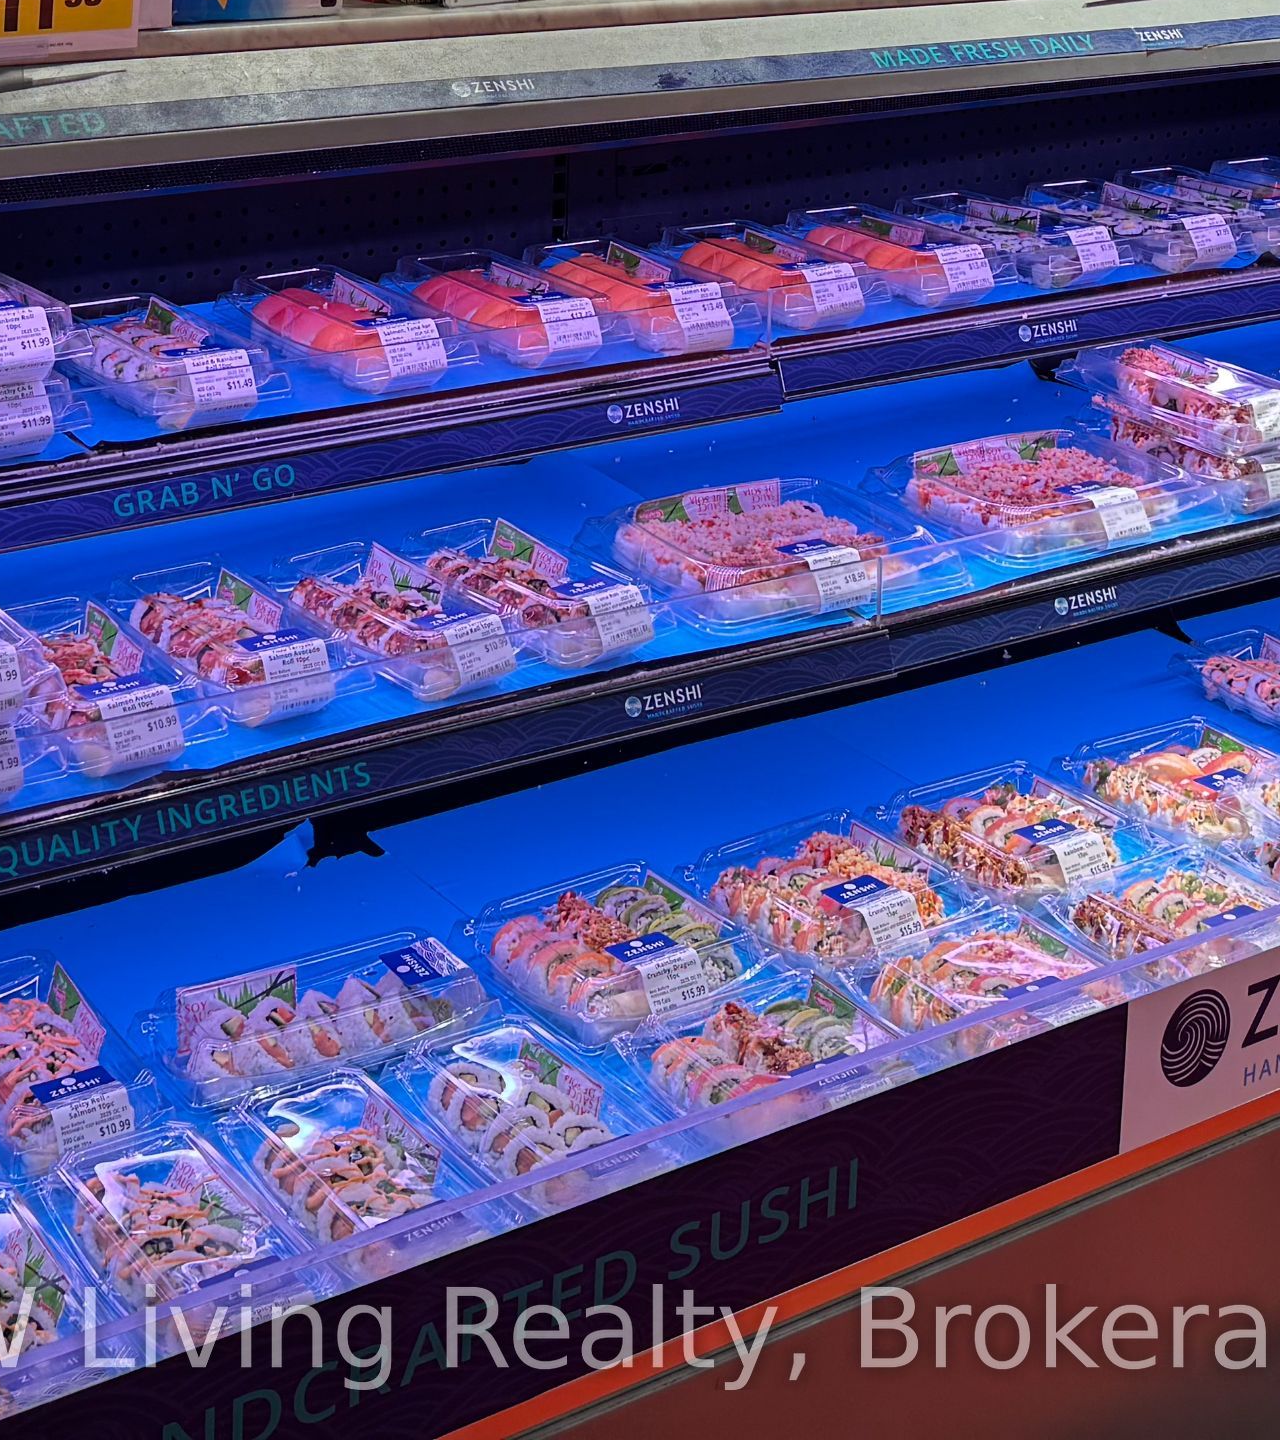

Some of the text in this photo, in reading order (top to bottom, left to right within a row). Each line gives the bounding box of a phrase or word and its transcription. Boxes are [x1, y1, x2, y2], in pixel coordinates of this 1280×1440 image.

[1138, 27, 1183, 44] ZENSHI
[871, 33, 1095, 69] MADE FRESH DAILY
[470, 76, 535, 96] ZENSHI
[1032, 319, 1078, 338] ZENSHI
[21, 337, 51, 351] $11.99
[226, 379, 253, 392] $11.49
[623, 397, 680, 422] ZENSHI
[113, 482, 199, 518] GRAB
[253, 463, 295, 492] GO
[1068, 586, 1117, 611] ZENSHI
[642, 684, 702, 709] ZENSHI
[147, 716, 177, 732] $10.99
[155, 762, 372, 838] INGREDIENTS
[681, 985, 706, 1001] $15.99
[100, 1119, 131, 1137] $10.99
[162, 1158, 860, 1440] NDCRAFTED SUSHI
